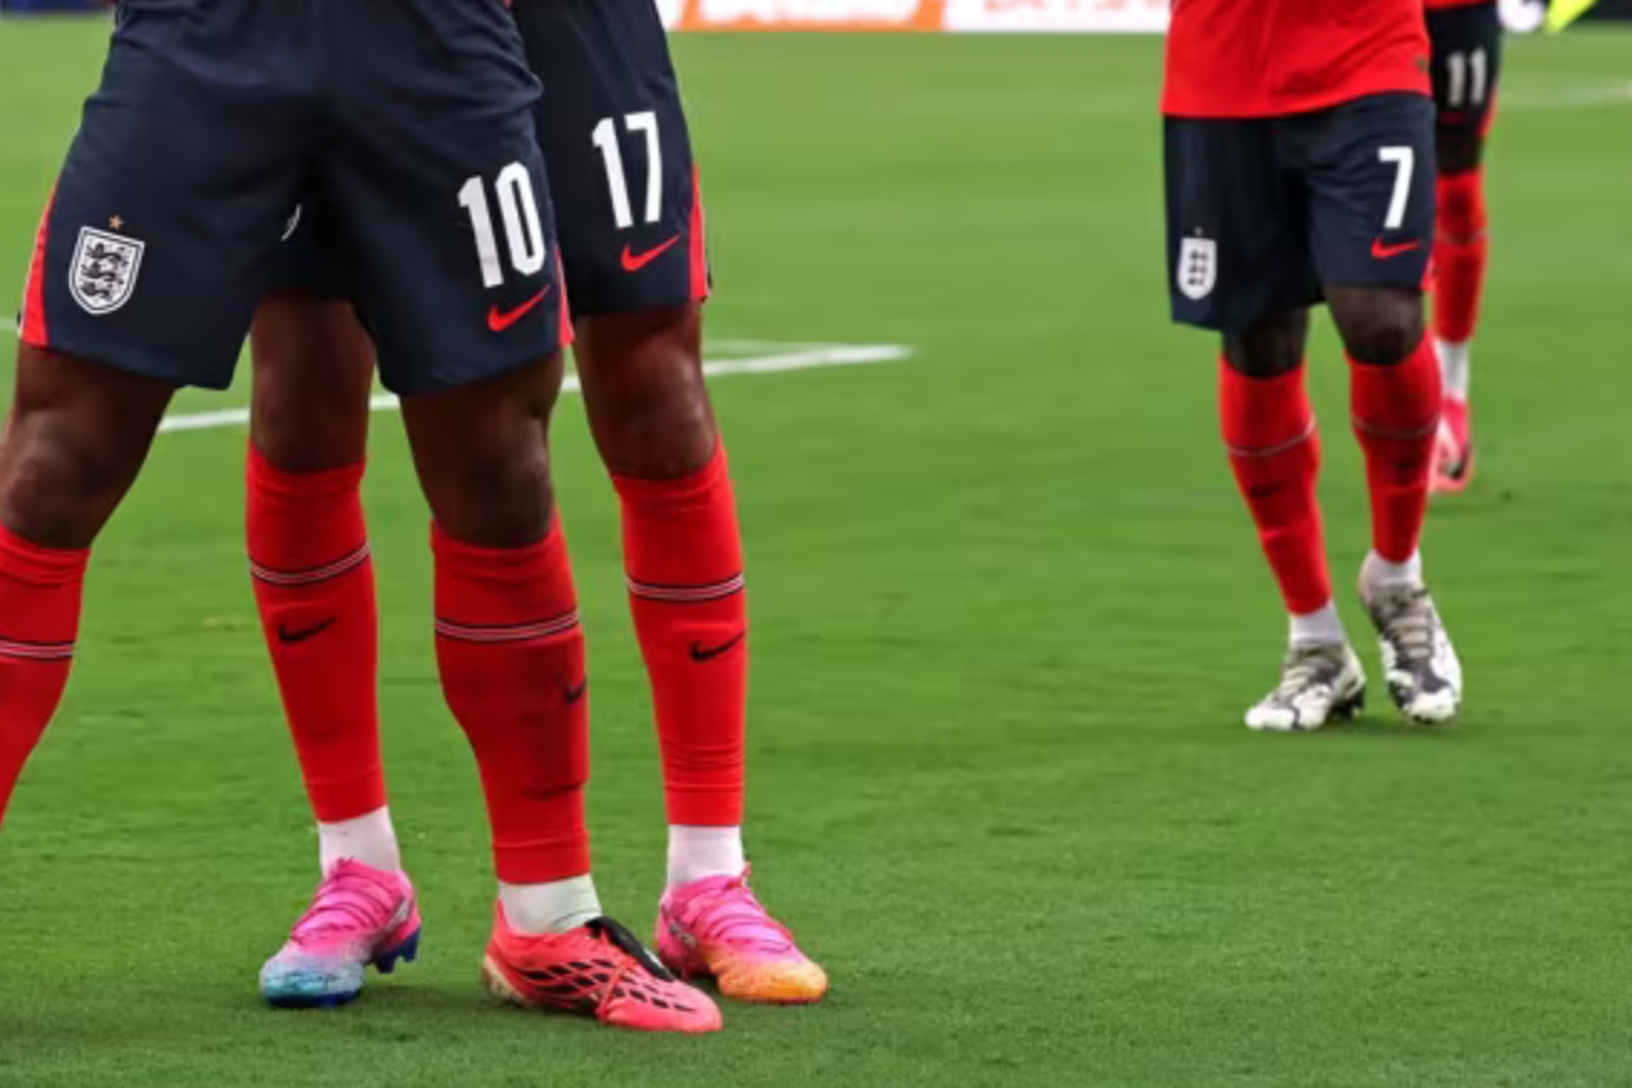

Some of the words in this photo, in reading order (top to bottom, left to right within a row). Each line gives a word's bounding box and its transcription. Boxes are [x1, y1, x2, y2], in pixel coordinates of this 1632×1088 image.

[1446, 46, 1487, 108] 11
[591, 110, 663, 230] 17
[1378, 145, 1415, 230] 7
[456, 160, 547, 290] 10
